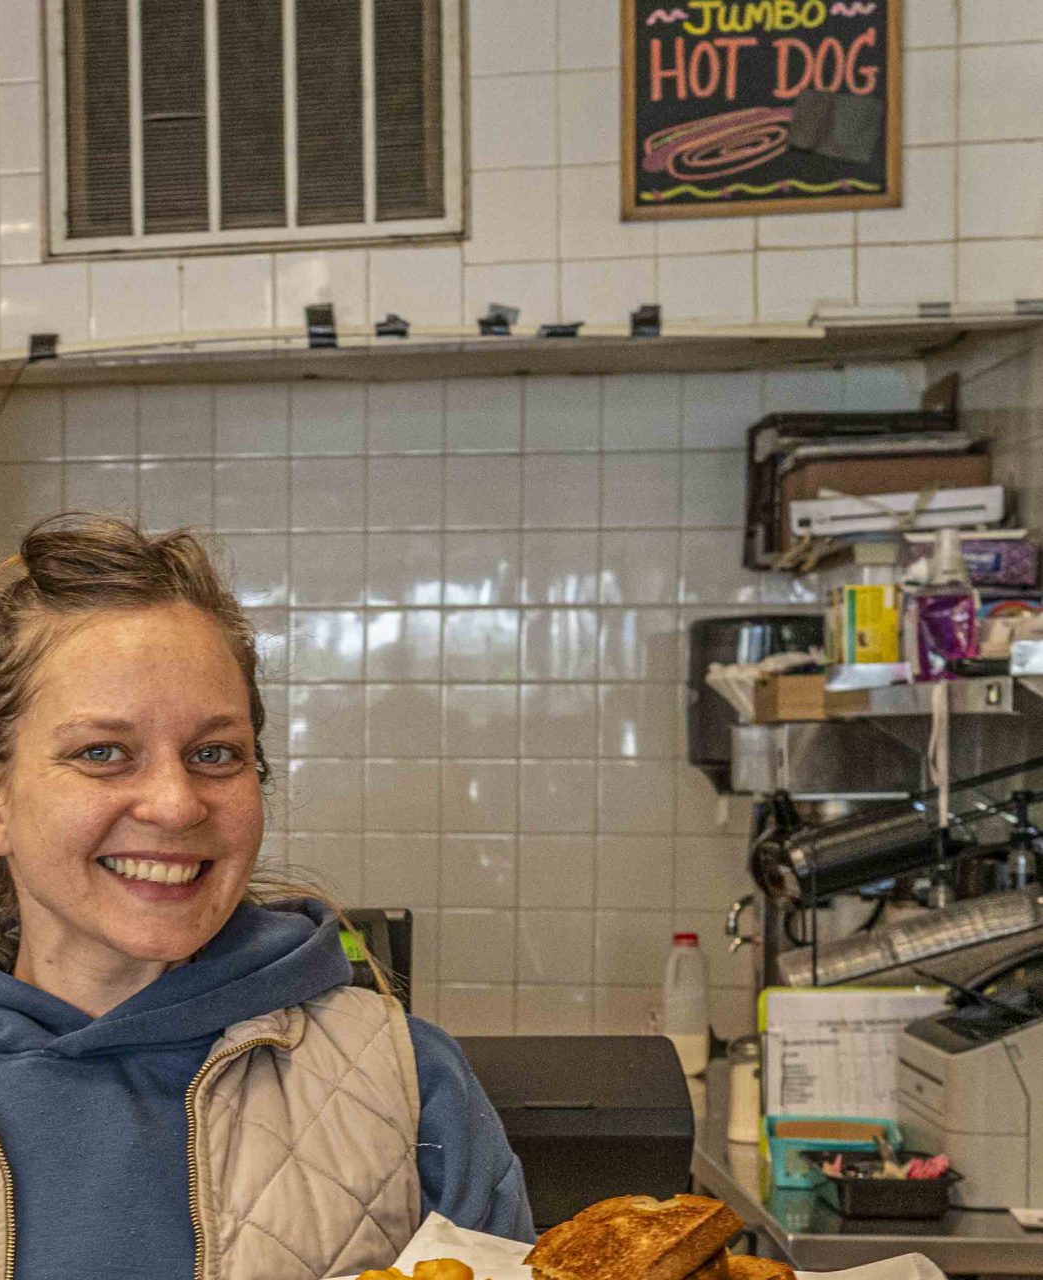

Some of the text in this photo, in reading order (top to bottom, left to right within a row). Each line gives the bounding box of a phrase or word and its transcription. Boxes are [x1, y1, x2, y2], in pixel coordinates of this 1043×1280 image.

[683, 0, 826, 35] JUMBO
[650, 28, 878, 100] HOT DOG
